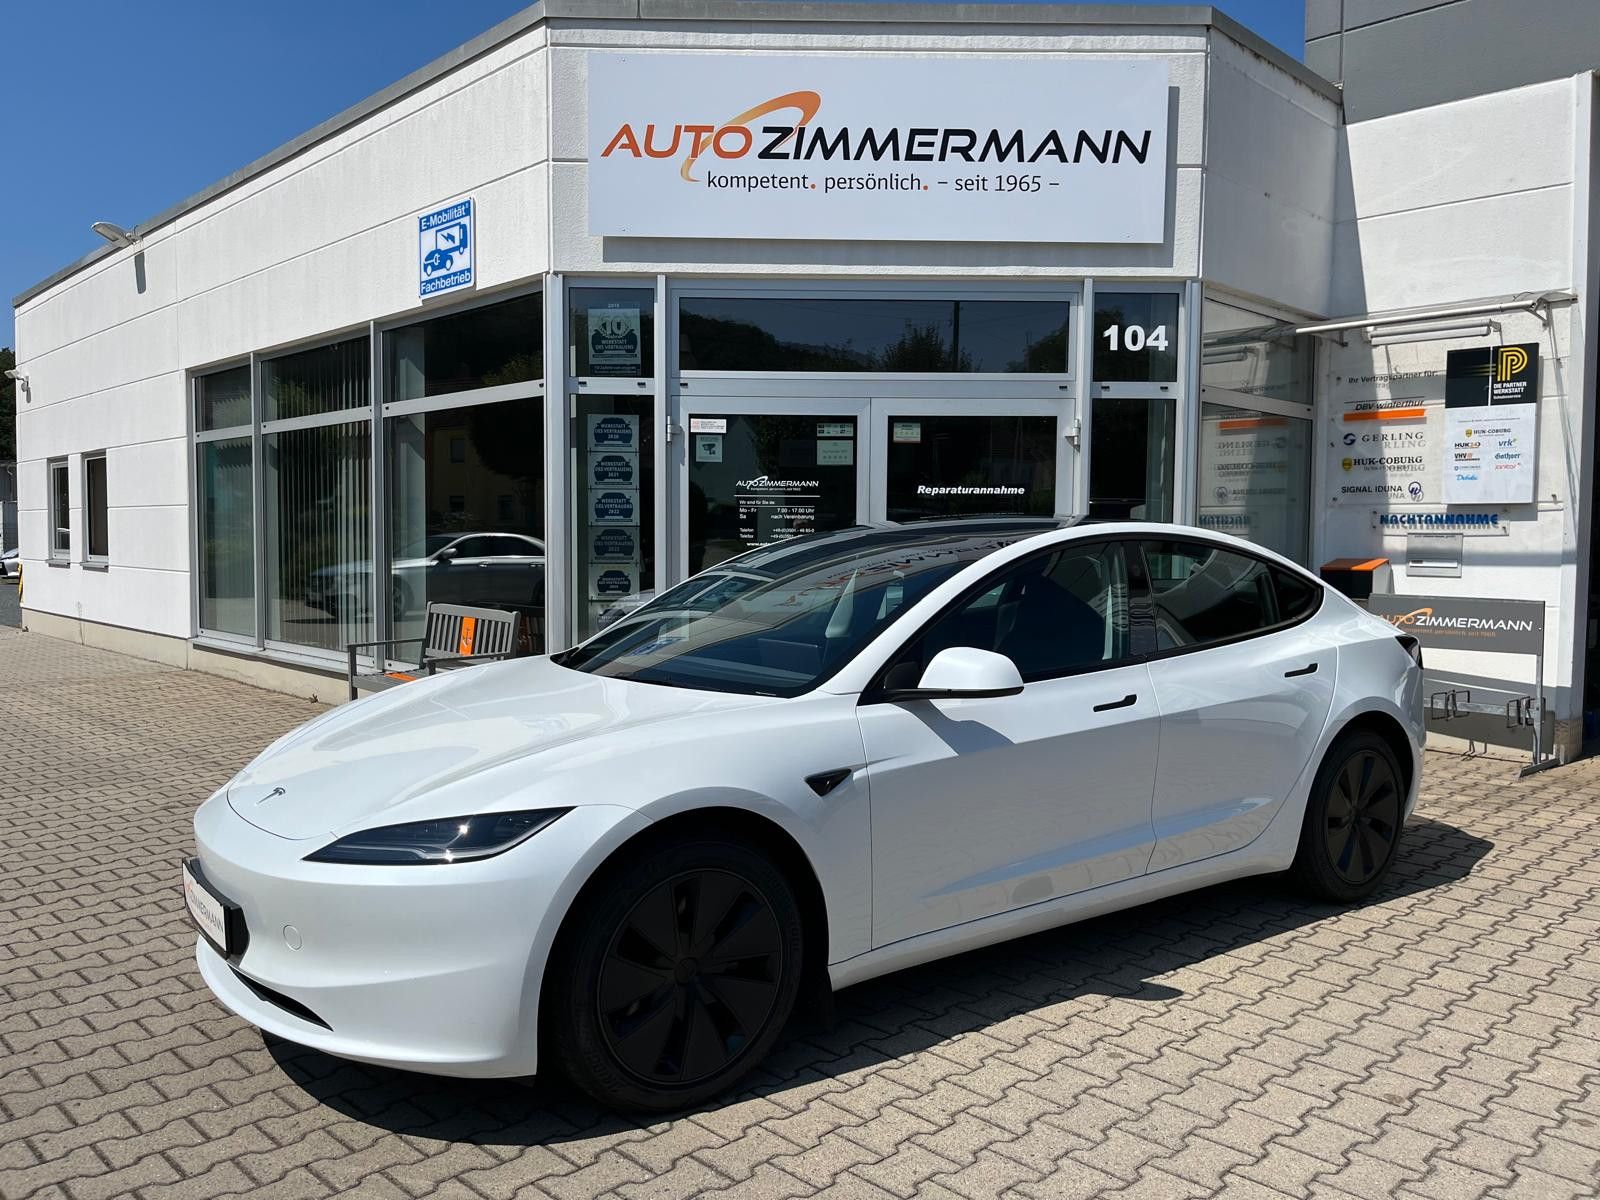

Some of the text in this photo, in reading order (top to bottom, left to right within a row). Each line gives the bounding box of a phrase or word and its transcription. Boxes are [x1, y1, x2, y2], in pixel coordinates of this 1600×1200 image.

[707, 170, 816, 192] kompetent.
[824, 172, 929, 194] persönlich.
[954, 174, 989, 192] seit
[995, 174, 1041, 192] 1965
[421, 205, 466, 230] E-Mobilität
[421, 271, 470, 293] Fachbetrieb
[1103, 324, 1168, 351] 104
[1360, 373, 1422, 383] Vertragspartner
[1361, 431, 1424, 442] GERLING
[1353, 456, 1423, 466] HUK-COBURG
[917, 485, 1025, 495] Reparaturannahme
[1341, 485, 1403, 494] SIGNAL IDUNA
[1380, 514, 1499, 525] NACHTANNAHME
